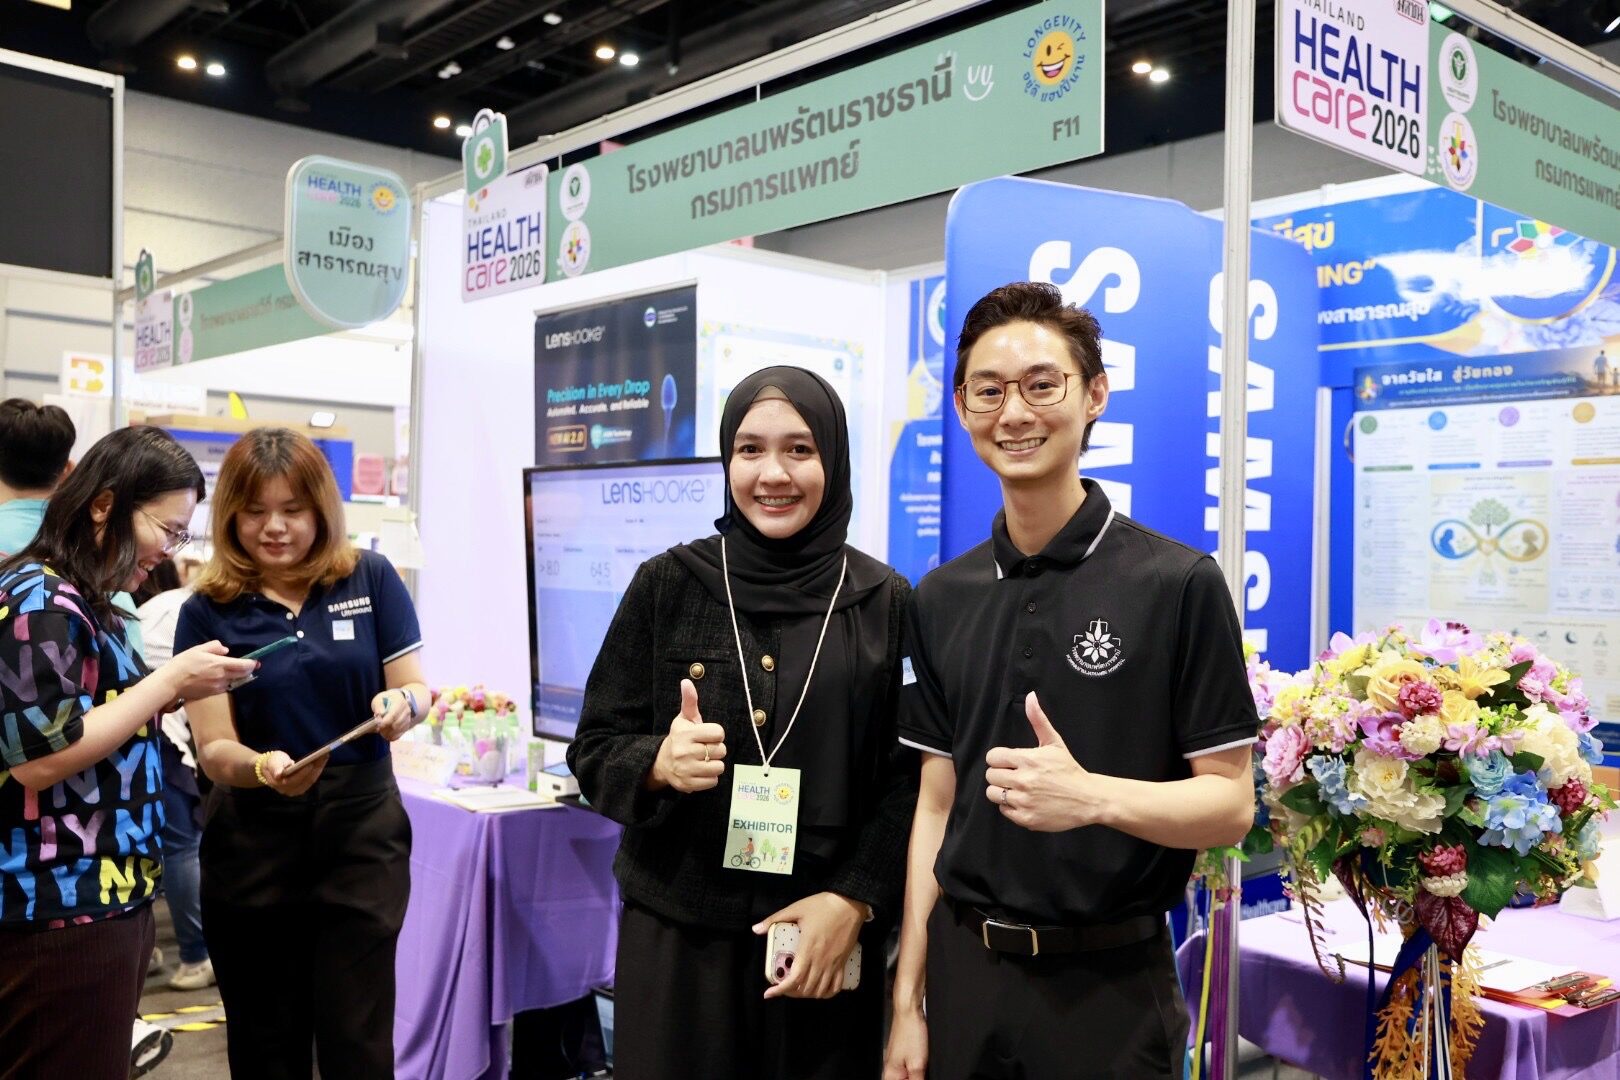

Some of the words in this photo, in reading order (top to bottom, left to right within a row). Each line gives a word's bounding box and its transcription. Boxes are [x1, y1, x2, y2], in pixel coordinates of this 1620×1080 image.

[1299, 0, 1365, 31] AILAND
[1023, 15, 1086, 58] LONGEVITY
[1294, 9, 1420, 114] HEALTH
[627, 56, 953, 194] โรงพยาบาลนพรัตนราชธานี
[1053, 115, 1080, 141] F11
[1293, 70, 1366, 139] care
[1372, 104, 1420, 158] 2026
[308, 175, 362, 197] HEALTH
[690, 140, 860, 219] กรมการแพทย์
[329, 226, 374, 252] เมือง
[468, 211, 541, 263] HEALTH
[466, 258, 507, 292] care
[509, 250, 540, 282] 2026
[587, 383, 597, 399] in
[598, 382, 622, 399] Every
[624, 379, 650, 396] Drop
[327, 596, 371, 613] SAMSUNG
[738, 784, 770, 794] HEALTH
[732, 819, 793, 834] EXHIBITOR
